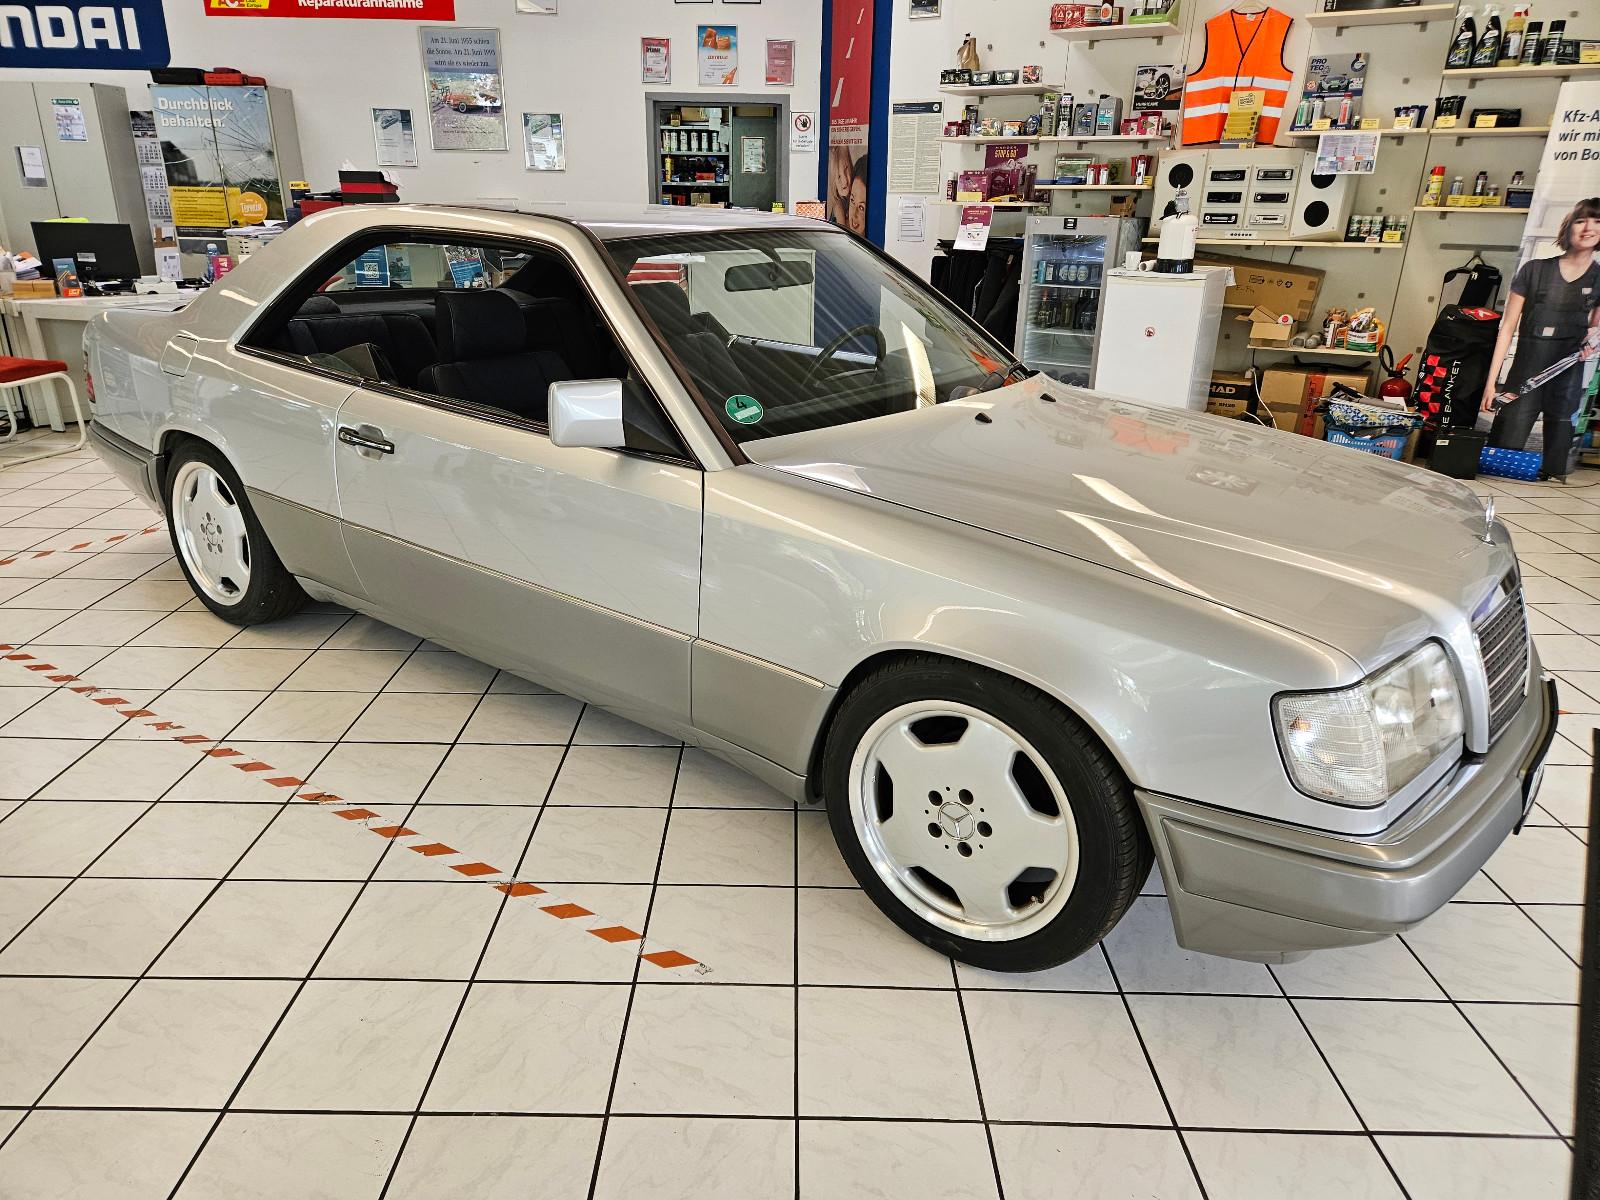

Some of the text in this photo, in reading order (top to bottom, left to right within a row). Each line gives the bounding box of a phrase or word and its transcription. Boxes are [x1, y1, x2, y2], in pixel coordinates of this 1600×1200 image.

[158, 97, 234, 111] Durchblick
[160, 113, 225, 127] behalten.
[1559, 129, 1580, 141] wir
[1554, 148, 1600, 161] von Bo
[735, 396, 748, 409] 4
